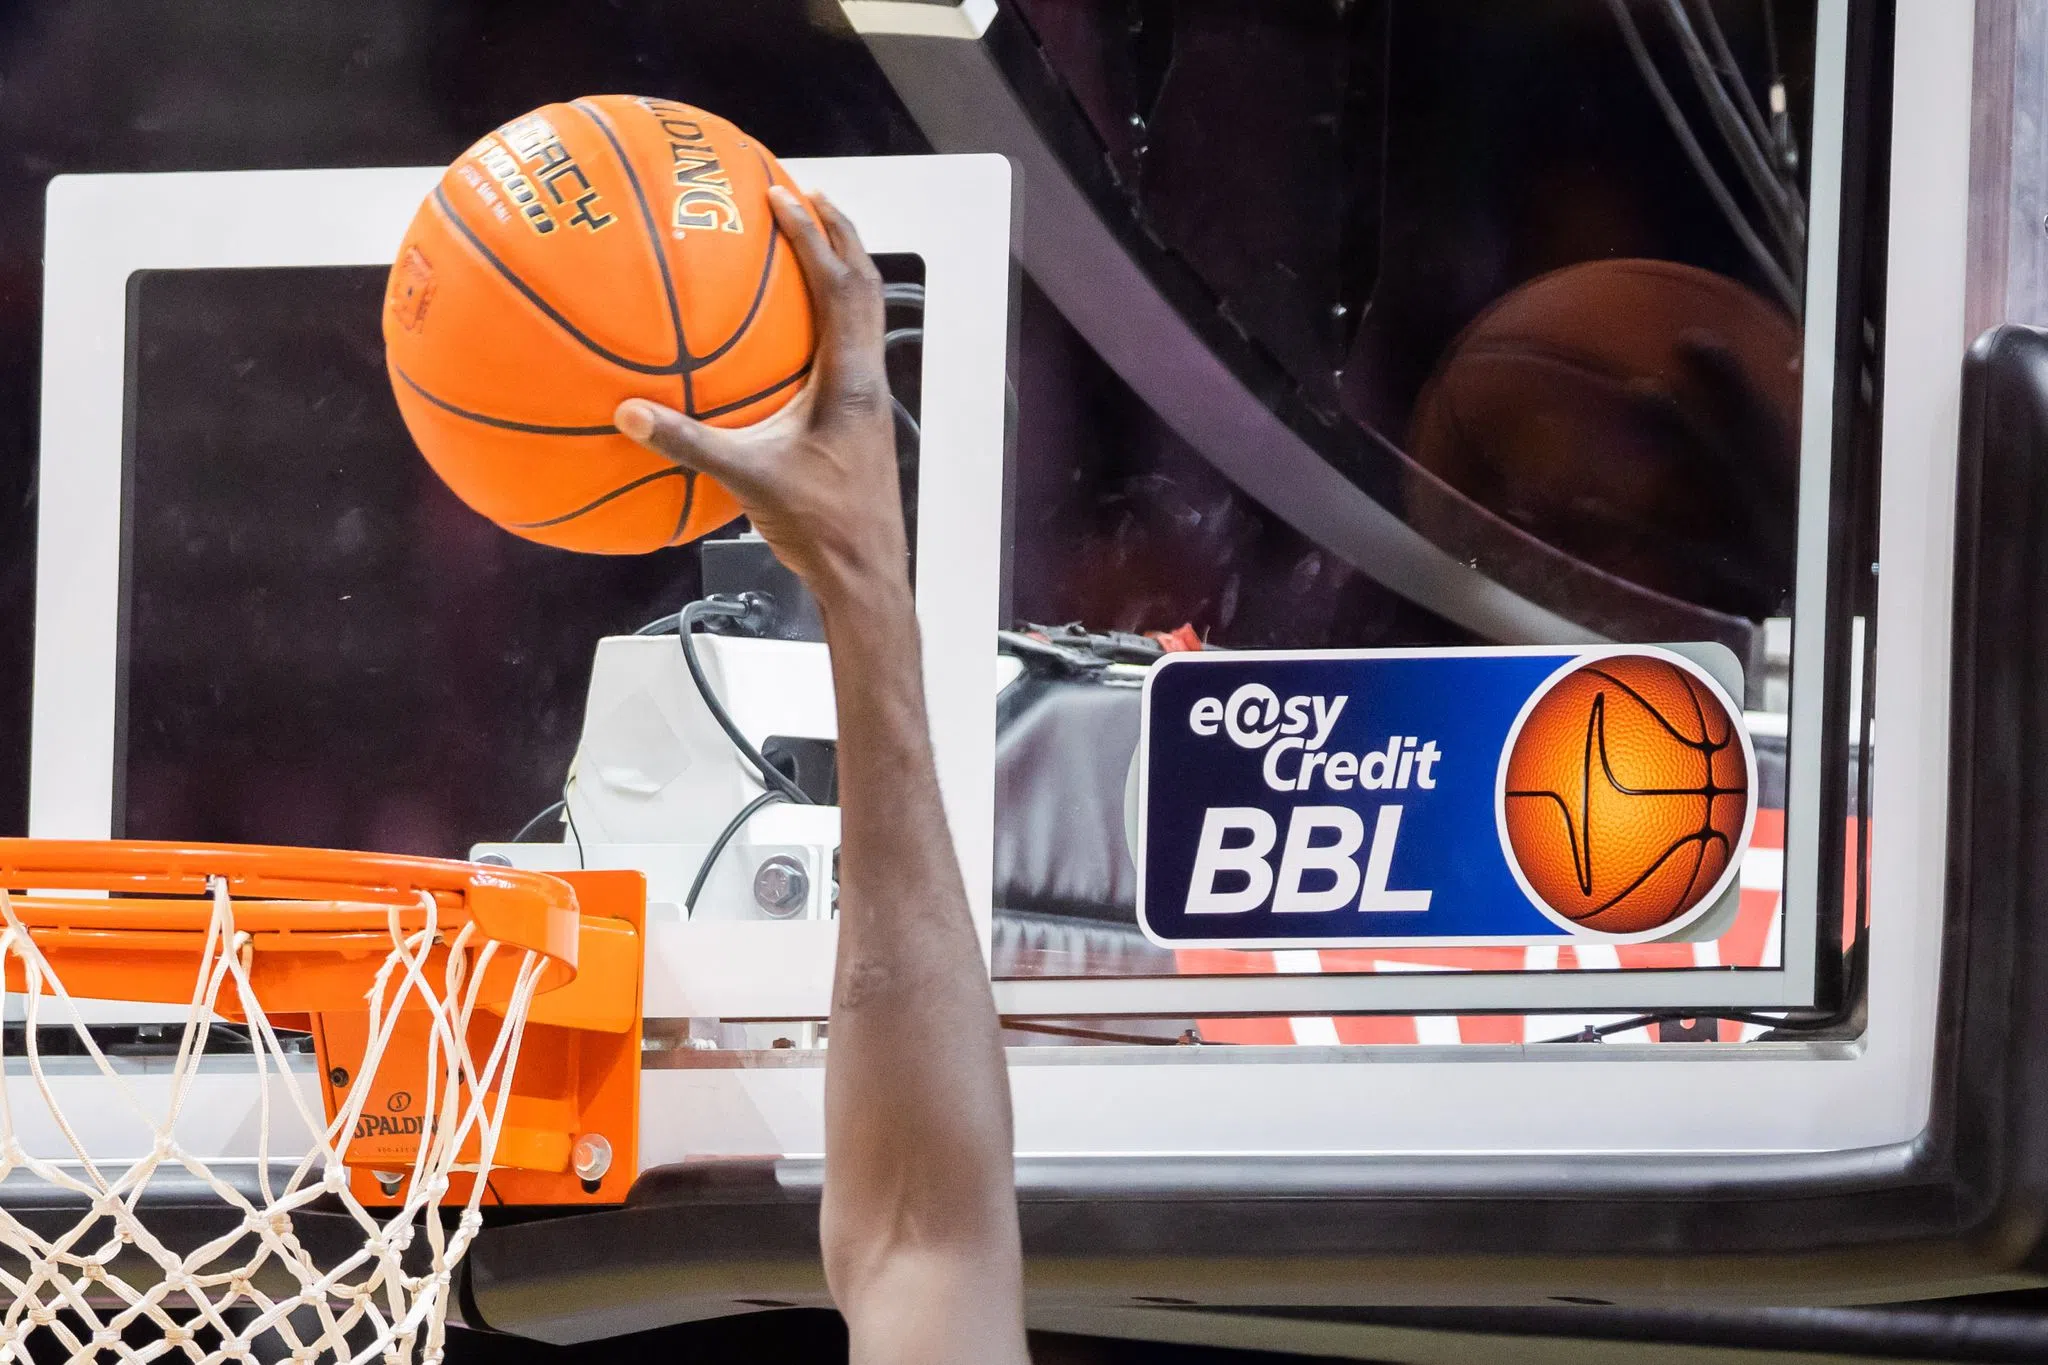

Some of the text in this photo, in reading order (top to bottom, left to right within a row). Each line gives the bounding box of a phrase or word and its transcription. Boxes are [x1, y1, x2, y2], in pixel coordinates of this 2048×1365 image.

[1189, 682, 1348, 749] e@sy
[1263, 736, 1442, 792] Credit
[1184, 804, 1433, 914] BBL
